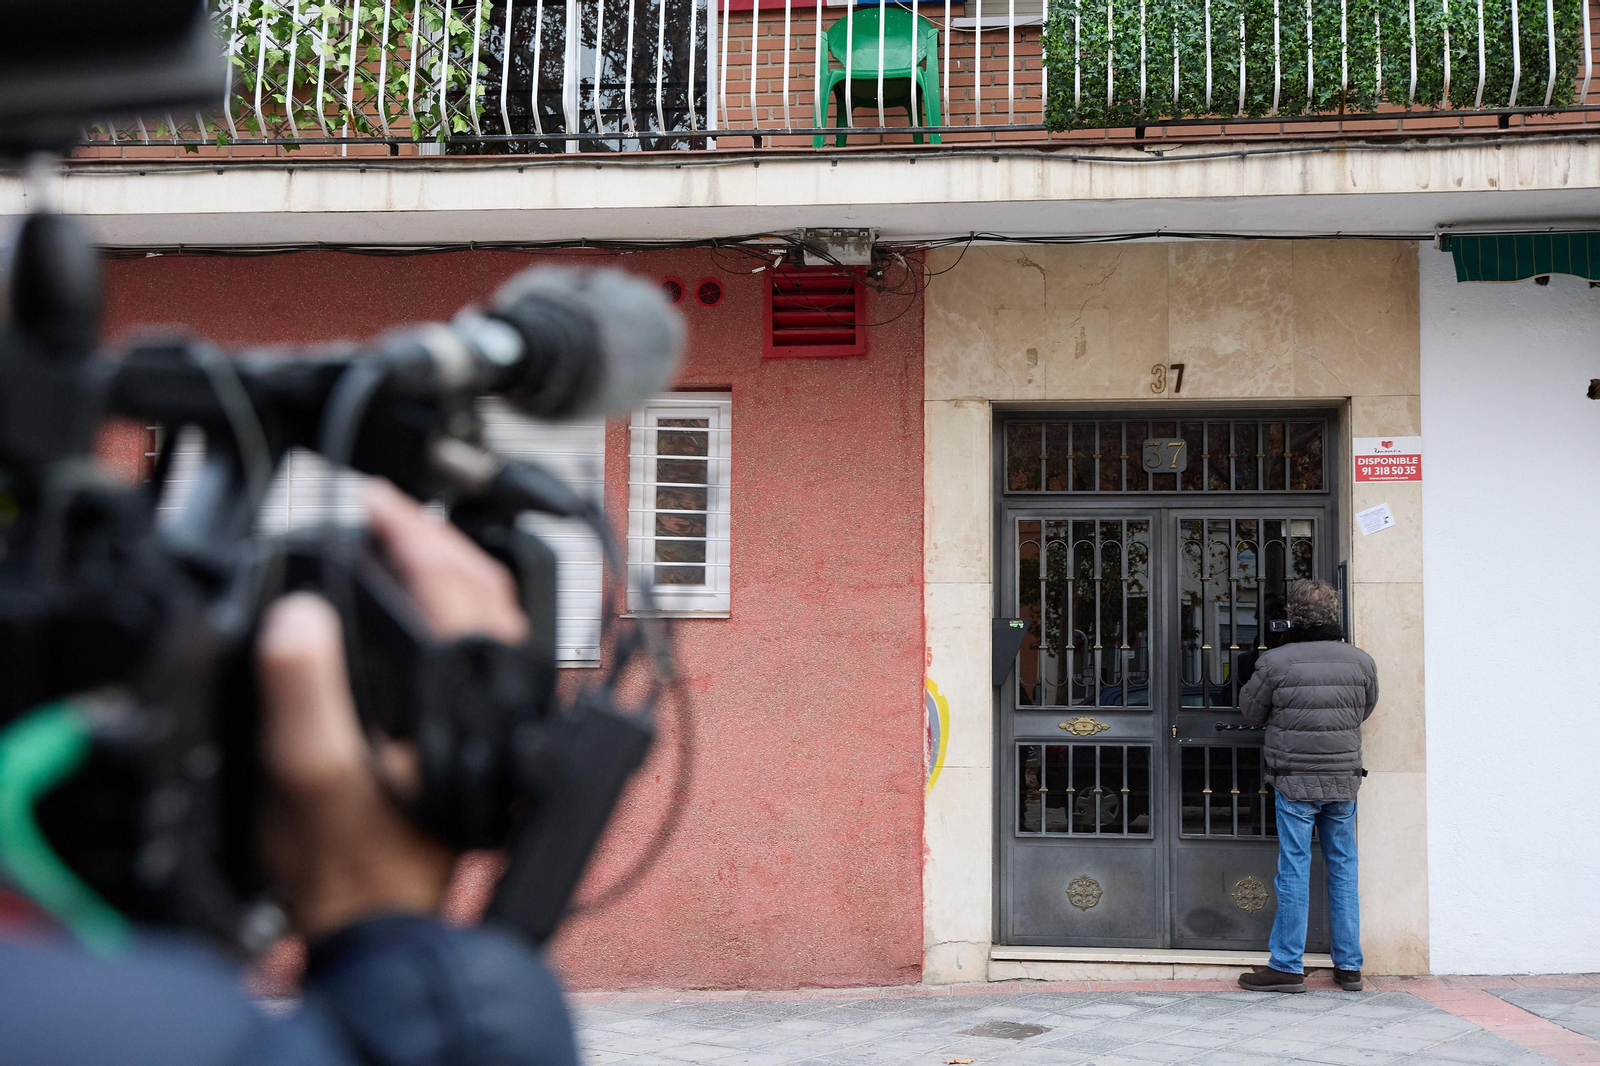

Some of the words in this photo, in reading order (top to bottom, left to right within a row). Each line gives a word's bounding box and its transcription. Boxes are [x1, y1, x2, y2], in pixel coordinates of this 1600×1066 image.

[1151, 364, 1185, 394] 37
[1145, 442, 1185, 469] 37
[1357, 457, 1419, 465] DISPONIBLE
[1361, 467, 1371, 475] 91
